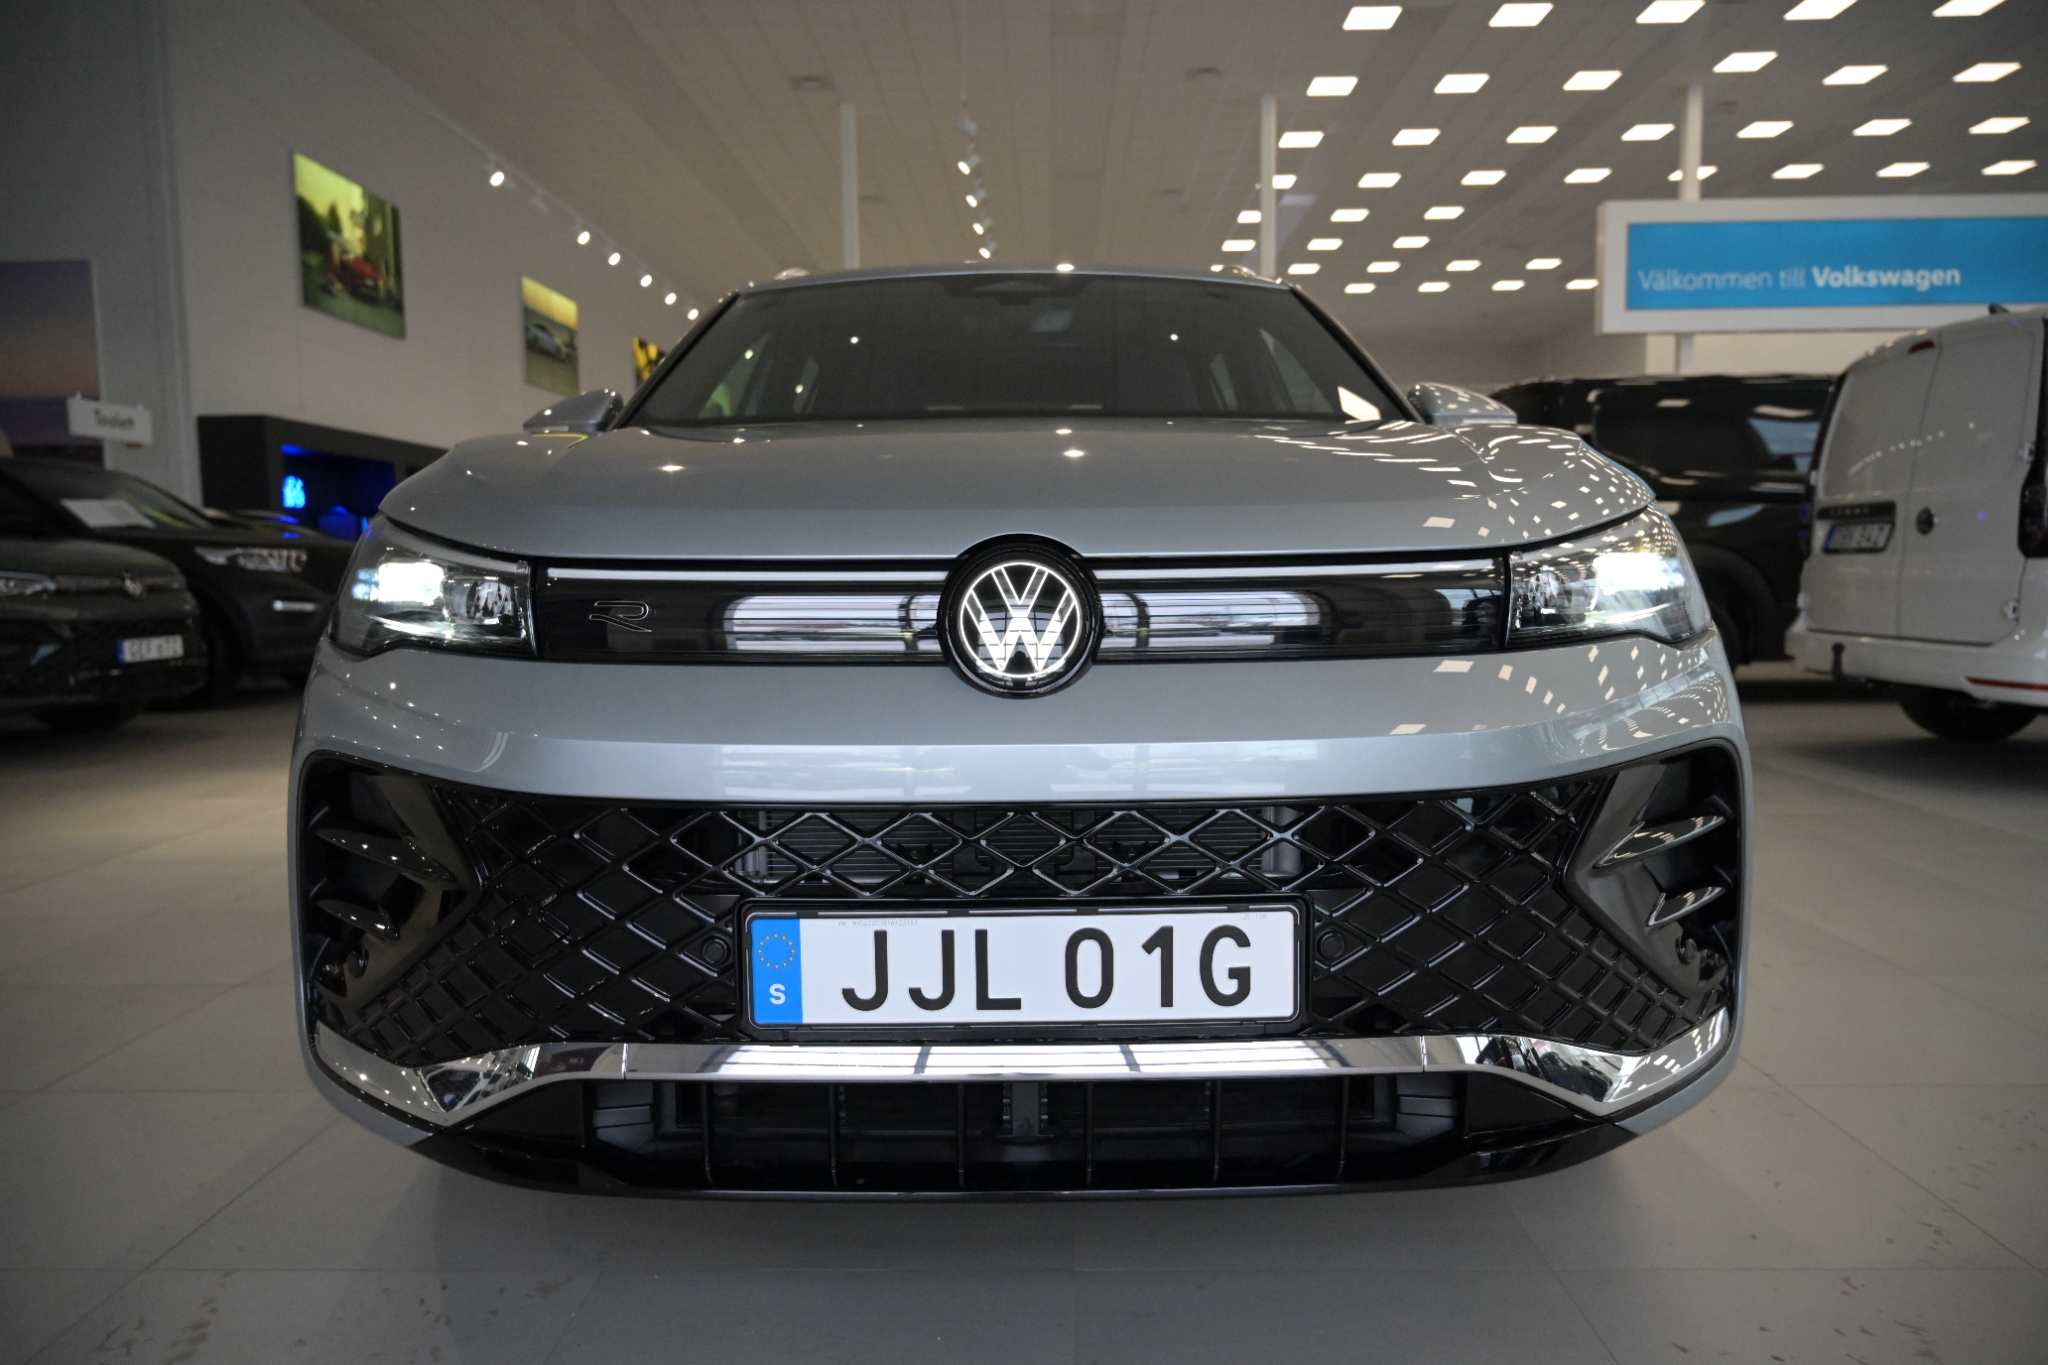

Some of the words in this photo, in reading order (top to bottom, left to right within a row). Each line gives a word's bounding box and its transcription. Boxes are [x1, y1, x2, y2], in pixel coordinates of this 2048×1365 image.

[1637, 267, 1774, 292] Välkommen
[1779, 265, 1806, 289] till
[1811, 264, 1961, 292] Volkswagen
[841, 929, 1022, 1012] JJL
[1064, 924, 1251, 1009] 01G
[769, 983, 786, 1006] S
